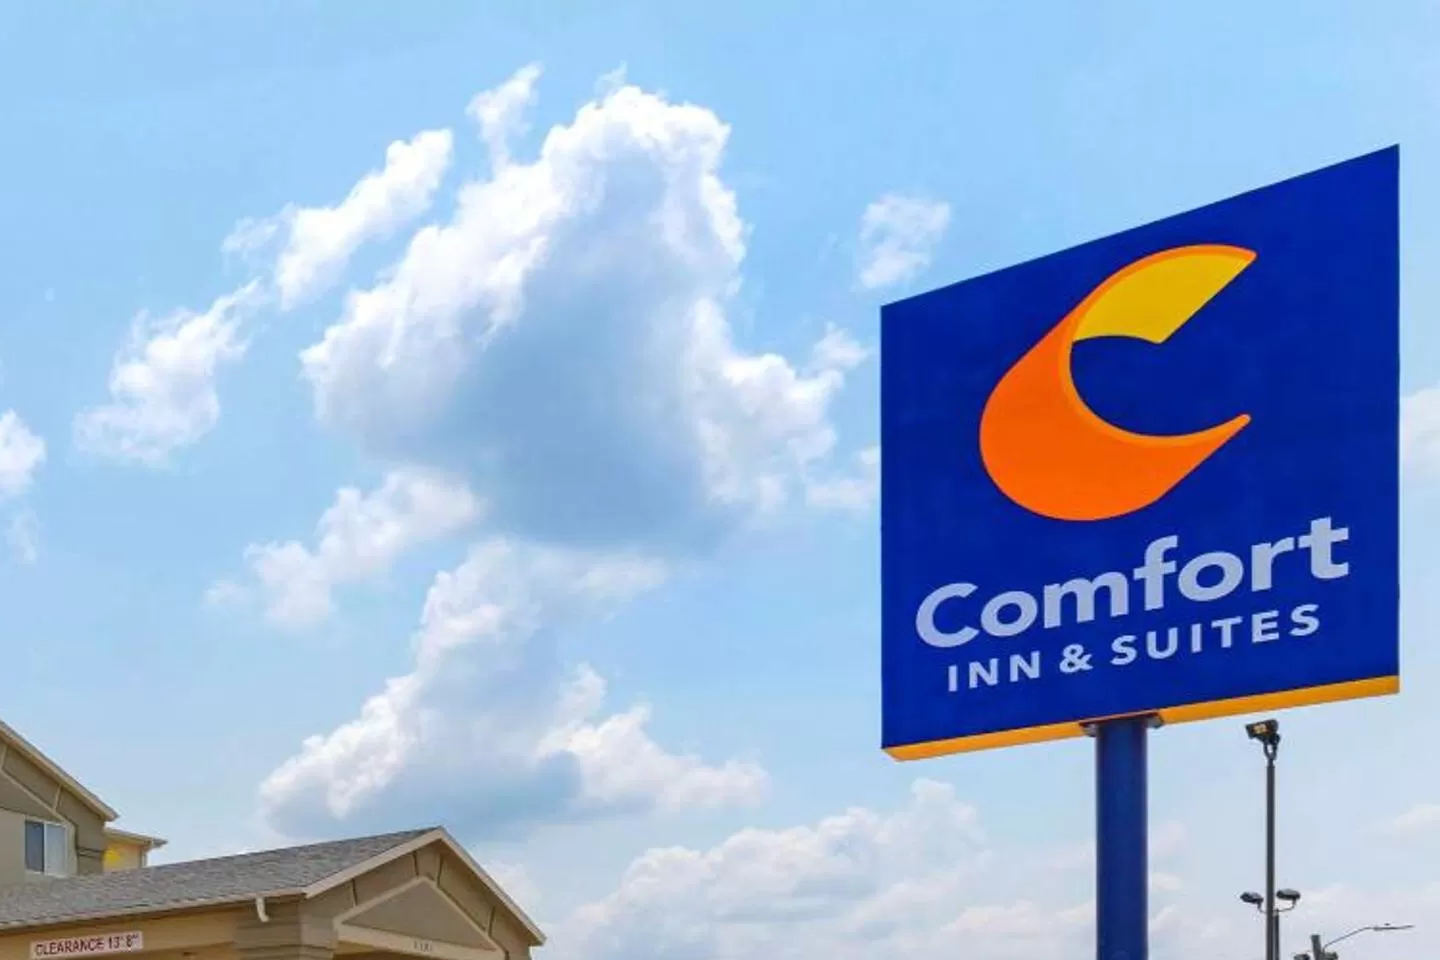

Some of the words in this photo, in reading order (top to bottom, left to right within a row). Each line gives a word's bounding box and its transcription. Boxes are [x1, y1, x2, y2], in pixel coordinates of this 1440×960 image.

[915, 516, 1349, 648] Comfort
[947, 650, 1041, 692] INN
[1059, 643, 1093, 674] &
[1110, 603, 1321, 666] SUITES
[35, 936, 105, 957] CLEARANCE
